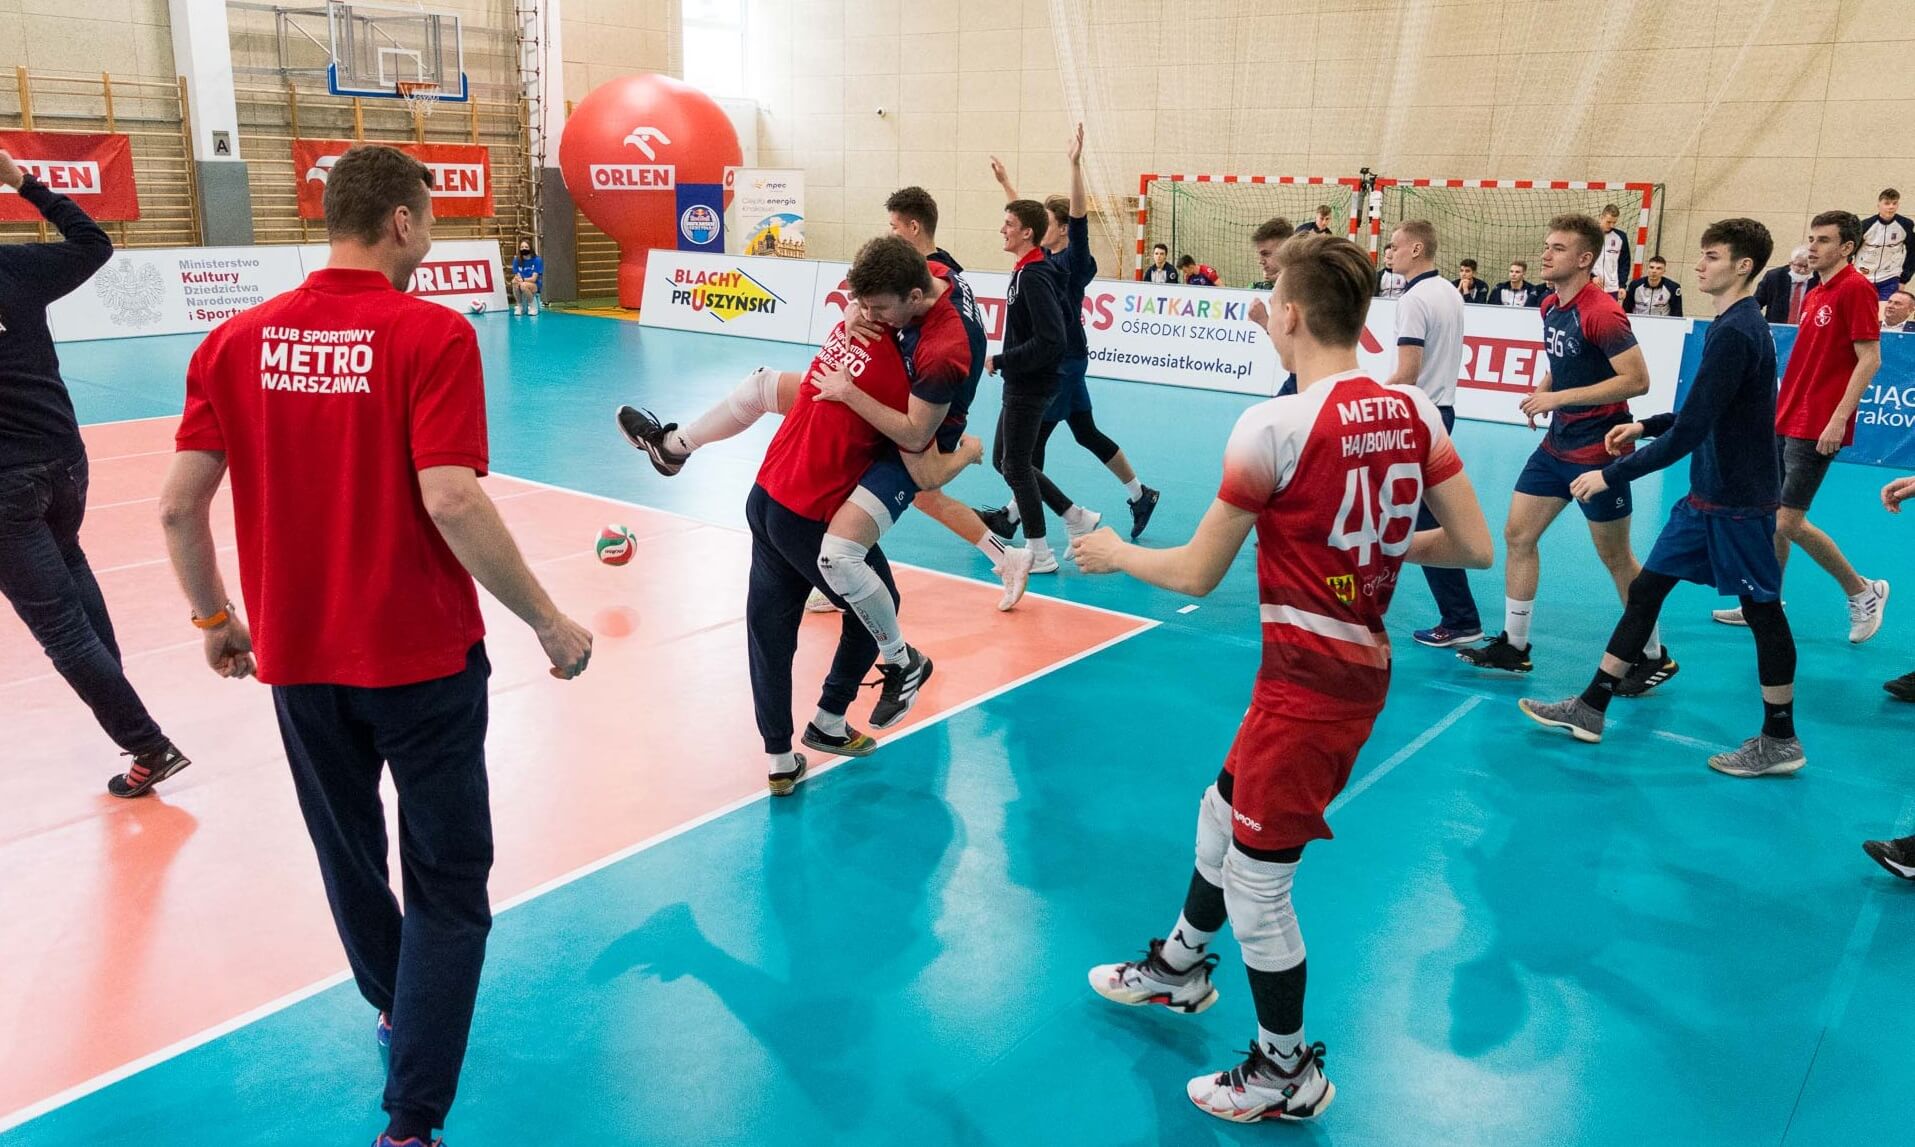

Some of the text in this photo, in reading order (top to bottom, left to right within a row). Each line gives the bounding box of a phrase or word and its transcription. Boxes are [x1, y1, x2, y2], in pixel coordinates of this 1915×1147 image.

[216, 139, 228, 153] A
[431, 169, 478, 191] LEN
[595, 168, 670, 187] ORLEN
[179, 258, 260, 270] Ministerstwo
[181, 271, 240, 284] Kultury
[674, 268, 742, 288] BLACHY
[184, 284, 259, 296] Dziedzictwa
[186, 295, 264, 307] Narodowego
[671, 288, 776, 314] PRUSZYŃSKI
[188, 307, 245, 322] i Sport
[262, 326, 375, 343] KLUB SPORTOWY
[1121, 318, 1257, 344] OŚRODKI SZKOLNE
[1546, 326, 1566, 358] 36
[261, 341, 373, 374] METRO
[261, 372, 371, 393] WARSZAWA
[1337, 396, 1410, 425] METRO
[1328, 462, 1423, 567] 48
